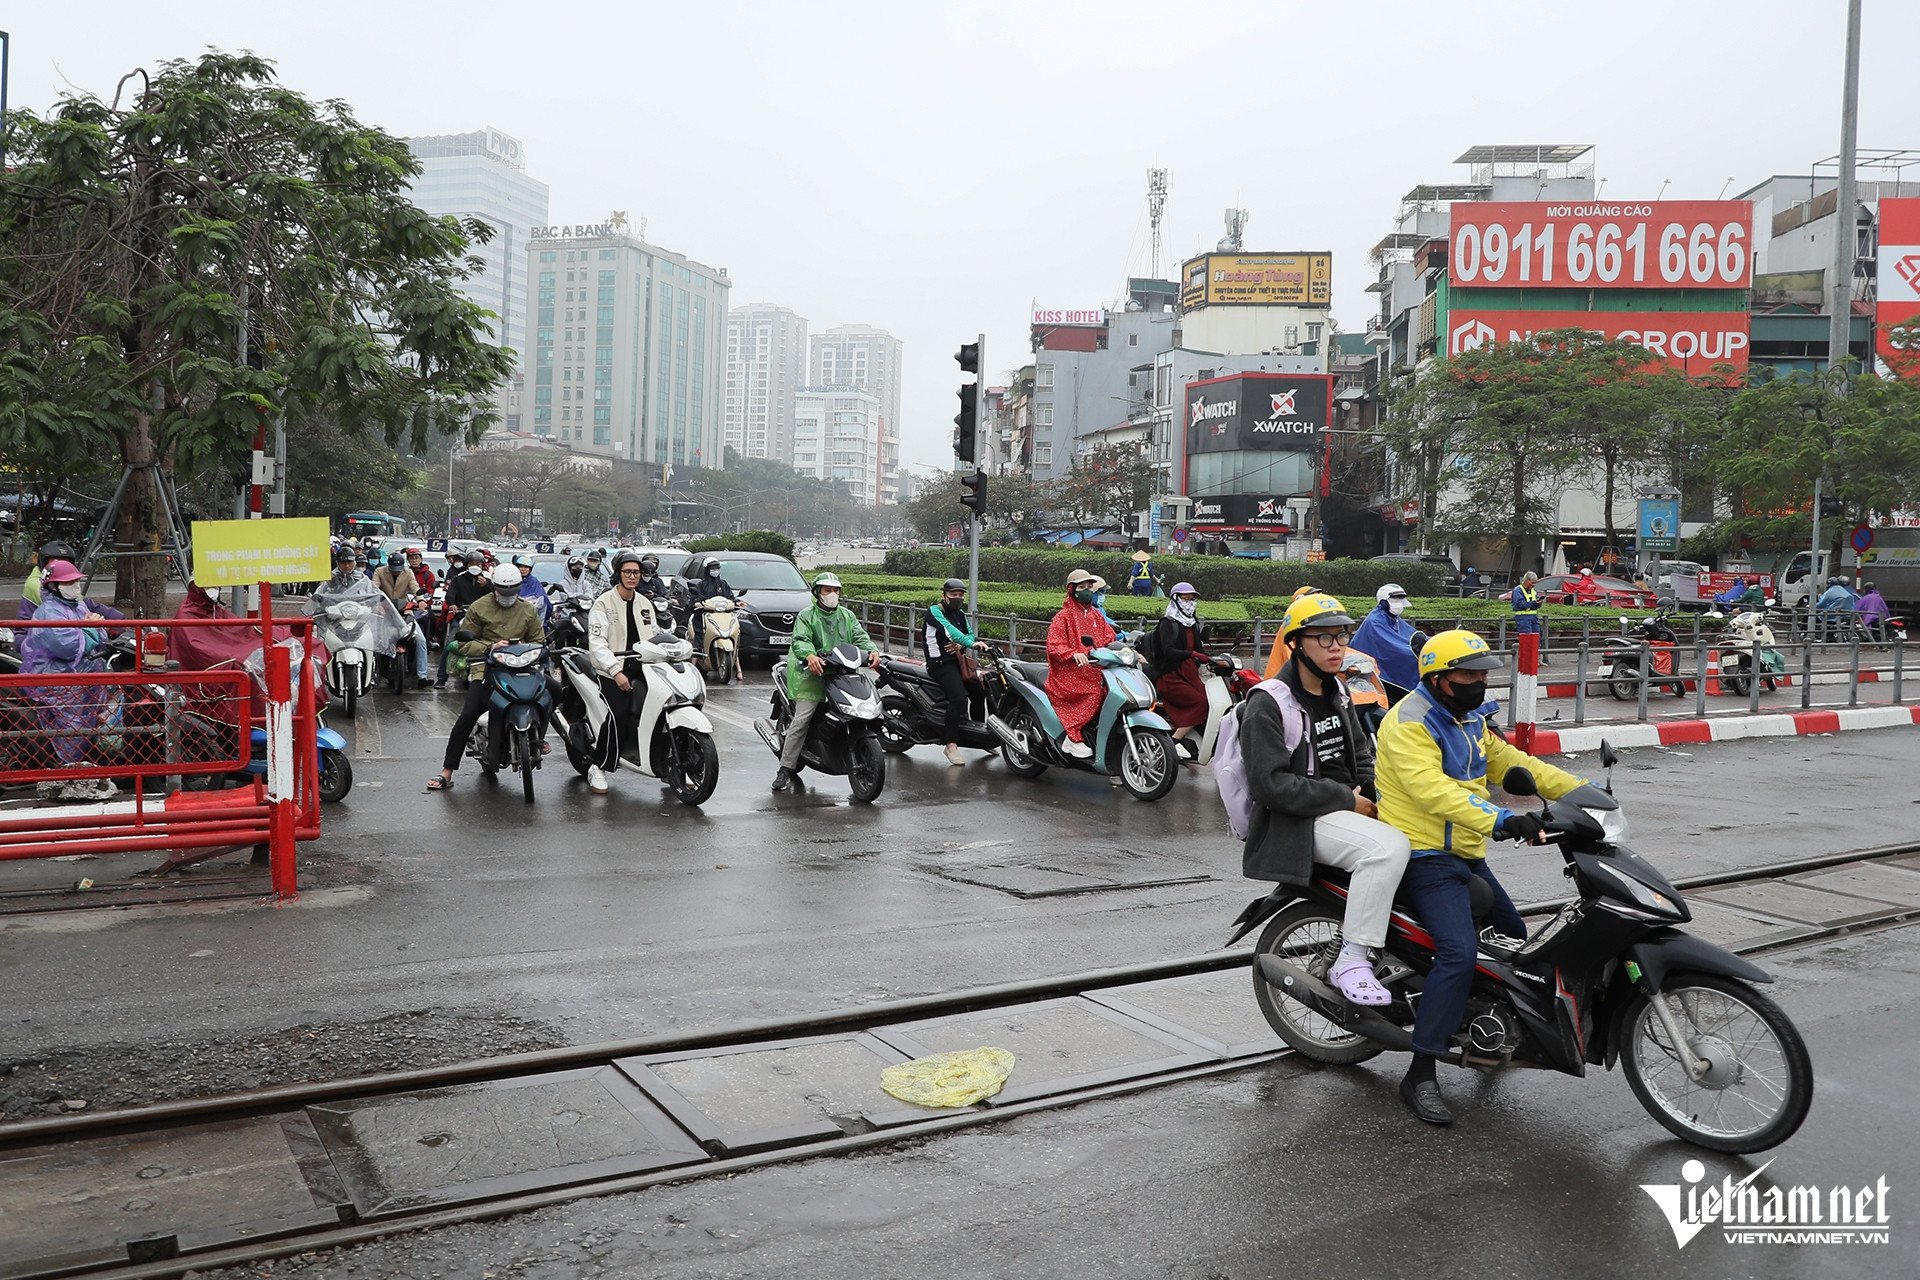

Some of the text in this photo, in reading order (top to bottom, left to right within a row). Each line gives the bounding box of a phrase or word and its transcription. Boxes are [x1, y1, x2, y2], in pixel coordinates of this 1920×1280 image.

[1547, 204, 1652, 217] MỜI QUẢNG CÁO
[530, 223, 613, 239] BAC A BANK
[1455, 222, 1746, 283] 0911 661 666
[1214, 269, 1304, 285] Hoàng Tùng
[1035, 311, 1101, 323] KISS HOTEL
[1616, 330, 1748, 359] GROUP
[1252, 420, 1314, 434] XWATCH
[1513, 969, 1546, 984] HONDA
